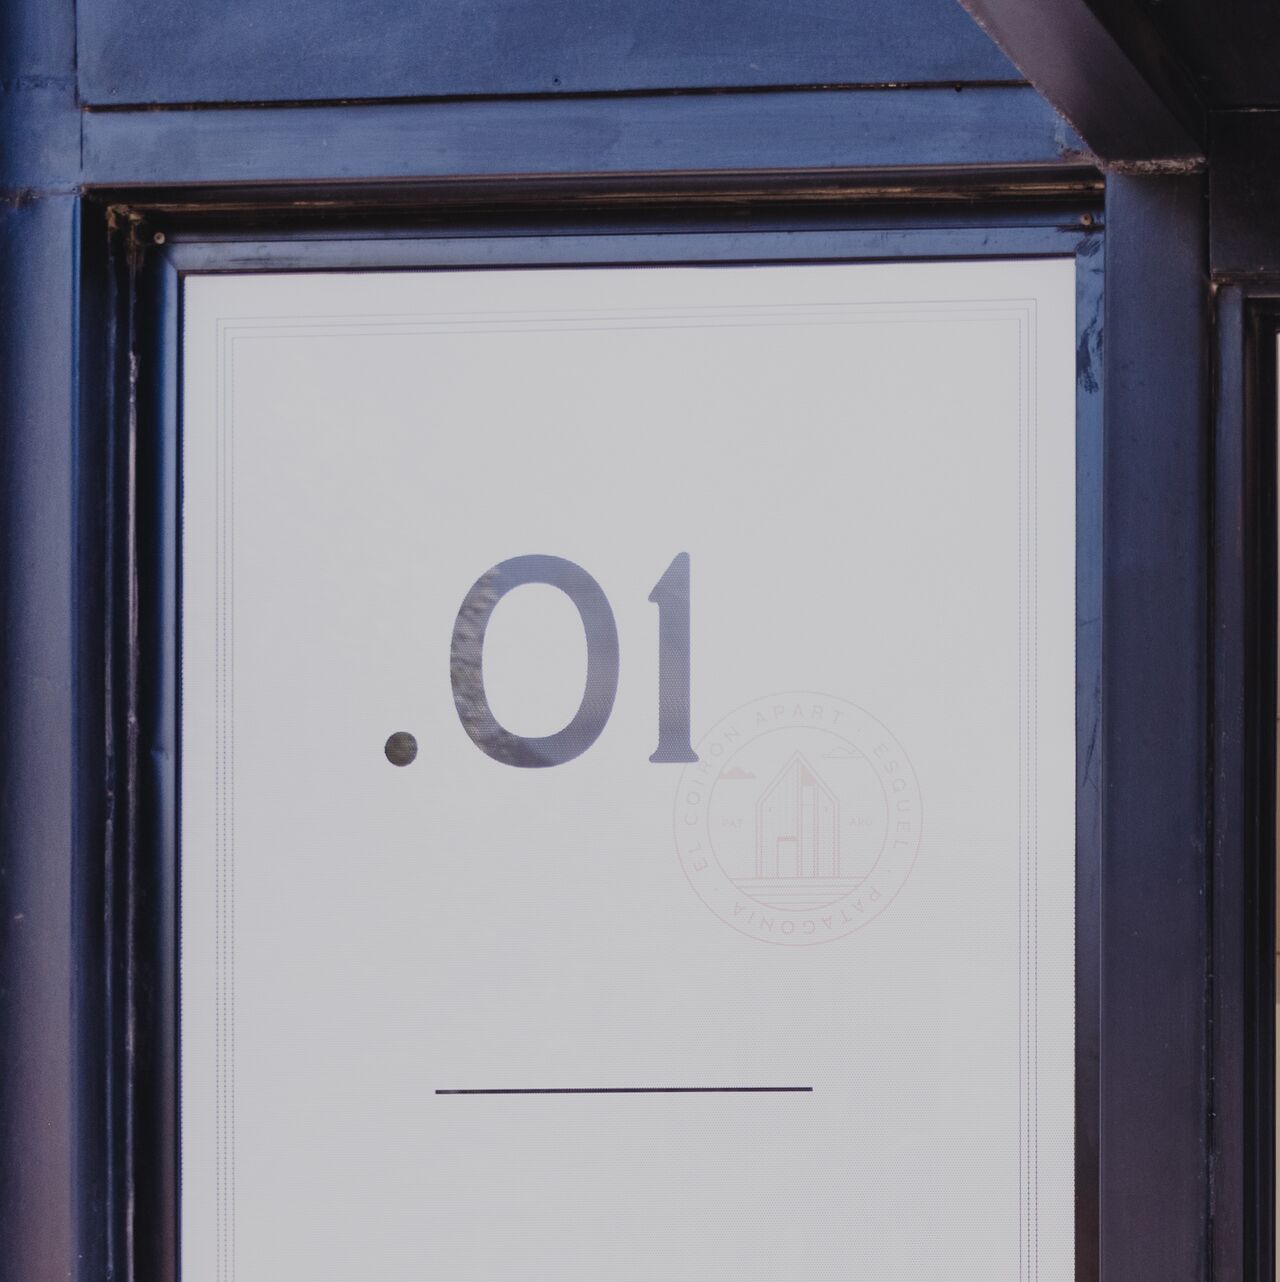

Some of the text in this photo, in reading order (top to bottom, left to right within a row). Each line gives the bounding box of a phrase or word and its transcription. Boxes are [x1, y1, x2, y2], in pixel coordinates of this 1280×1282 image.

[384, 551, 700, 769] .01
[754, 702, 846, 728] APART
[872, 741, 911, 849] ESQUEL
[732, 885, 884, 936] PATAGONIA
